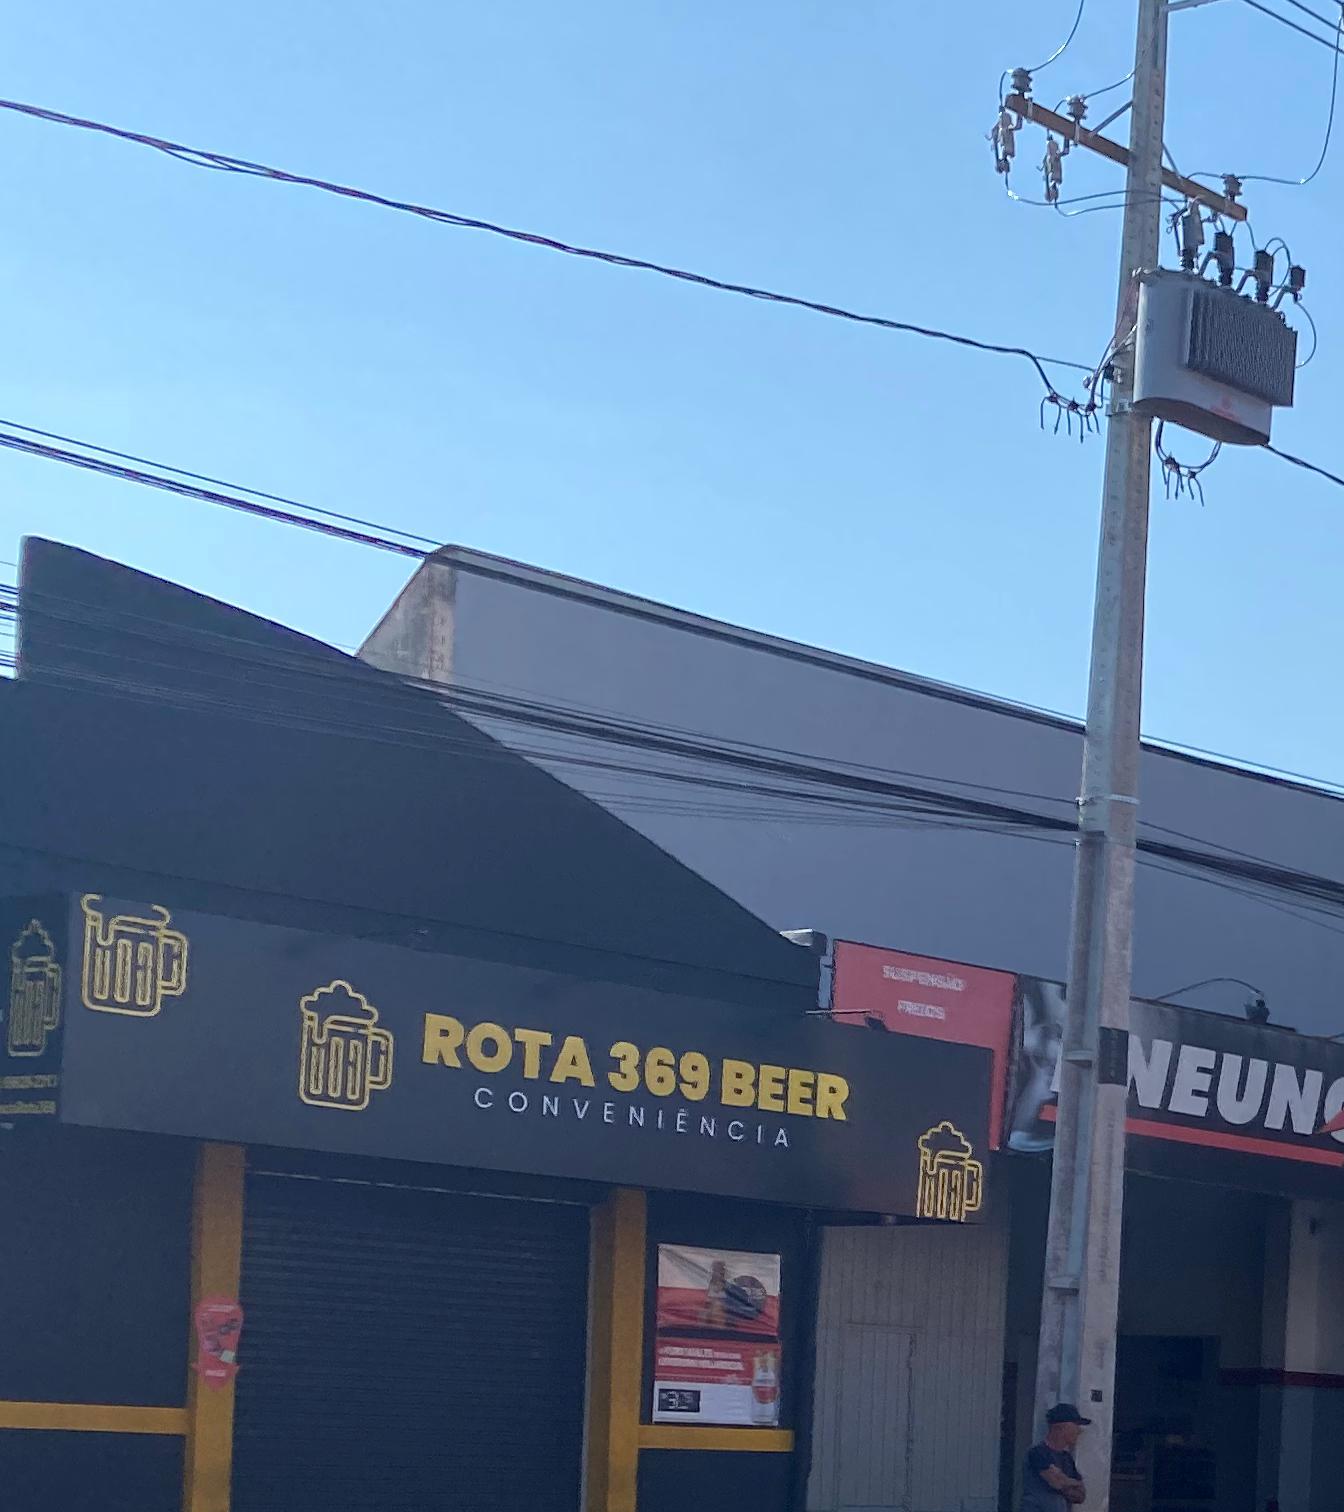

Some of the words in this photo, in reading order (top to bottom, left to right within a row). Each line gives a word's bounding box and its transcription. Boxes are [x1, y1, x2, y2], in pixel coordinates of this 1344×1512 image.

[422, 1013, 595, 1087] ROTA
[607, 1042, 710, 1101] 369
[720, 1059, 849, 1121] BEER
[474, 1088, 790, 1147] CONVENIÊNCIA
